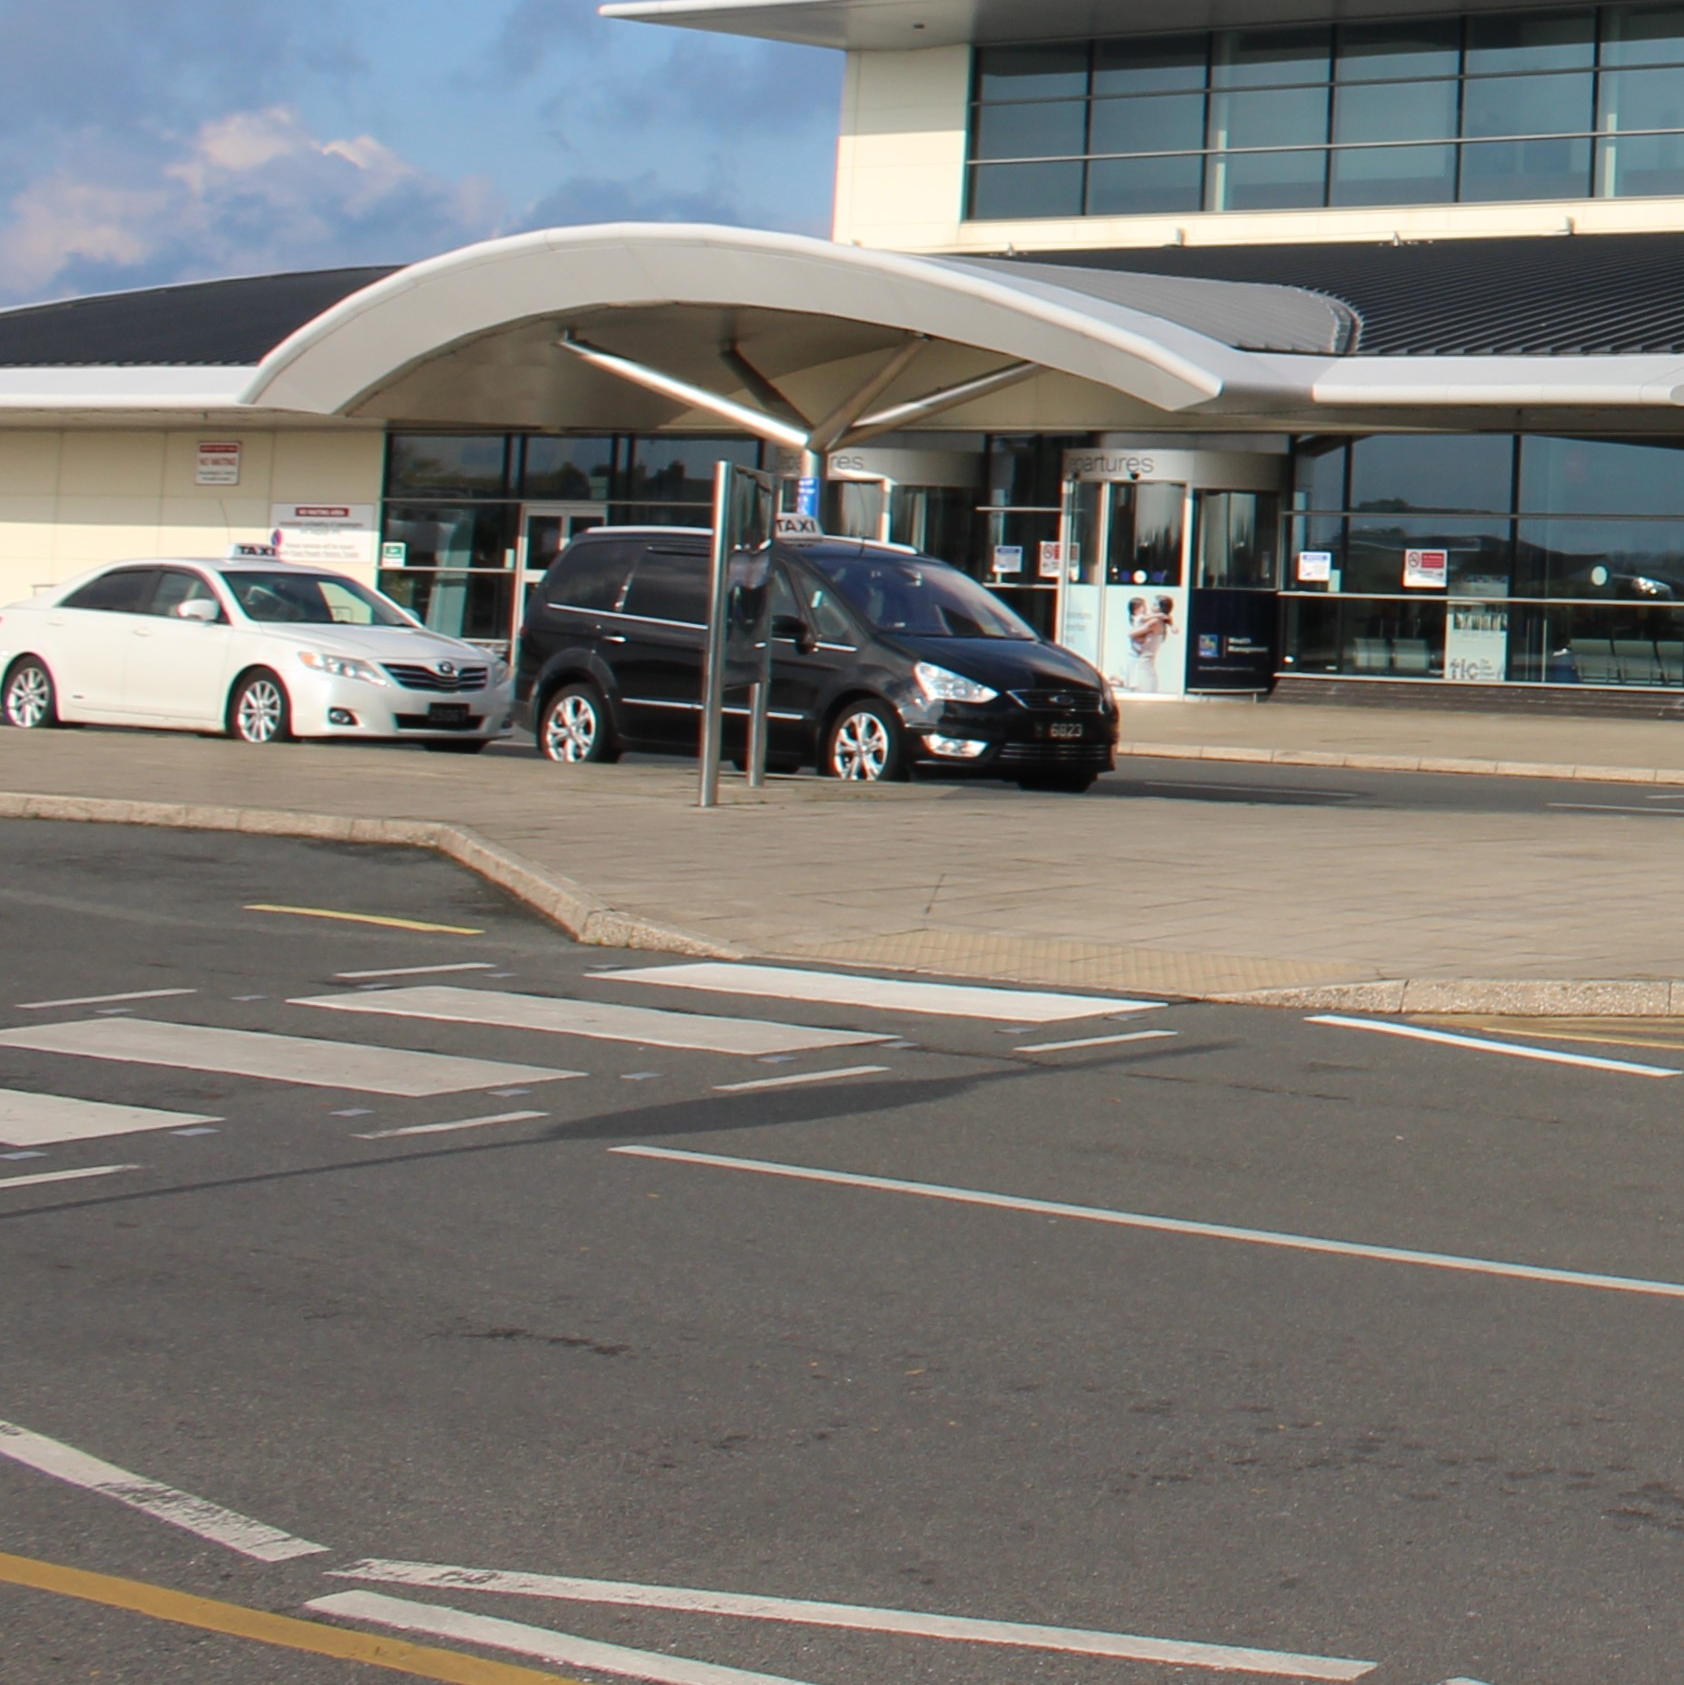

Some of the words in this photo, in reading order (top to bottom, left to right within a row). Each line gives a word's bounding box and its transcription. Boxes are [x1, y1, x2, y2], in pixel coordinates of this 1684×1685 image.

[775, 519, 816, 533] TAXI
[239, 545, 276, 557] TAXI
[1050, 723, 1082, 737] 6823
